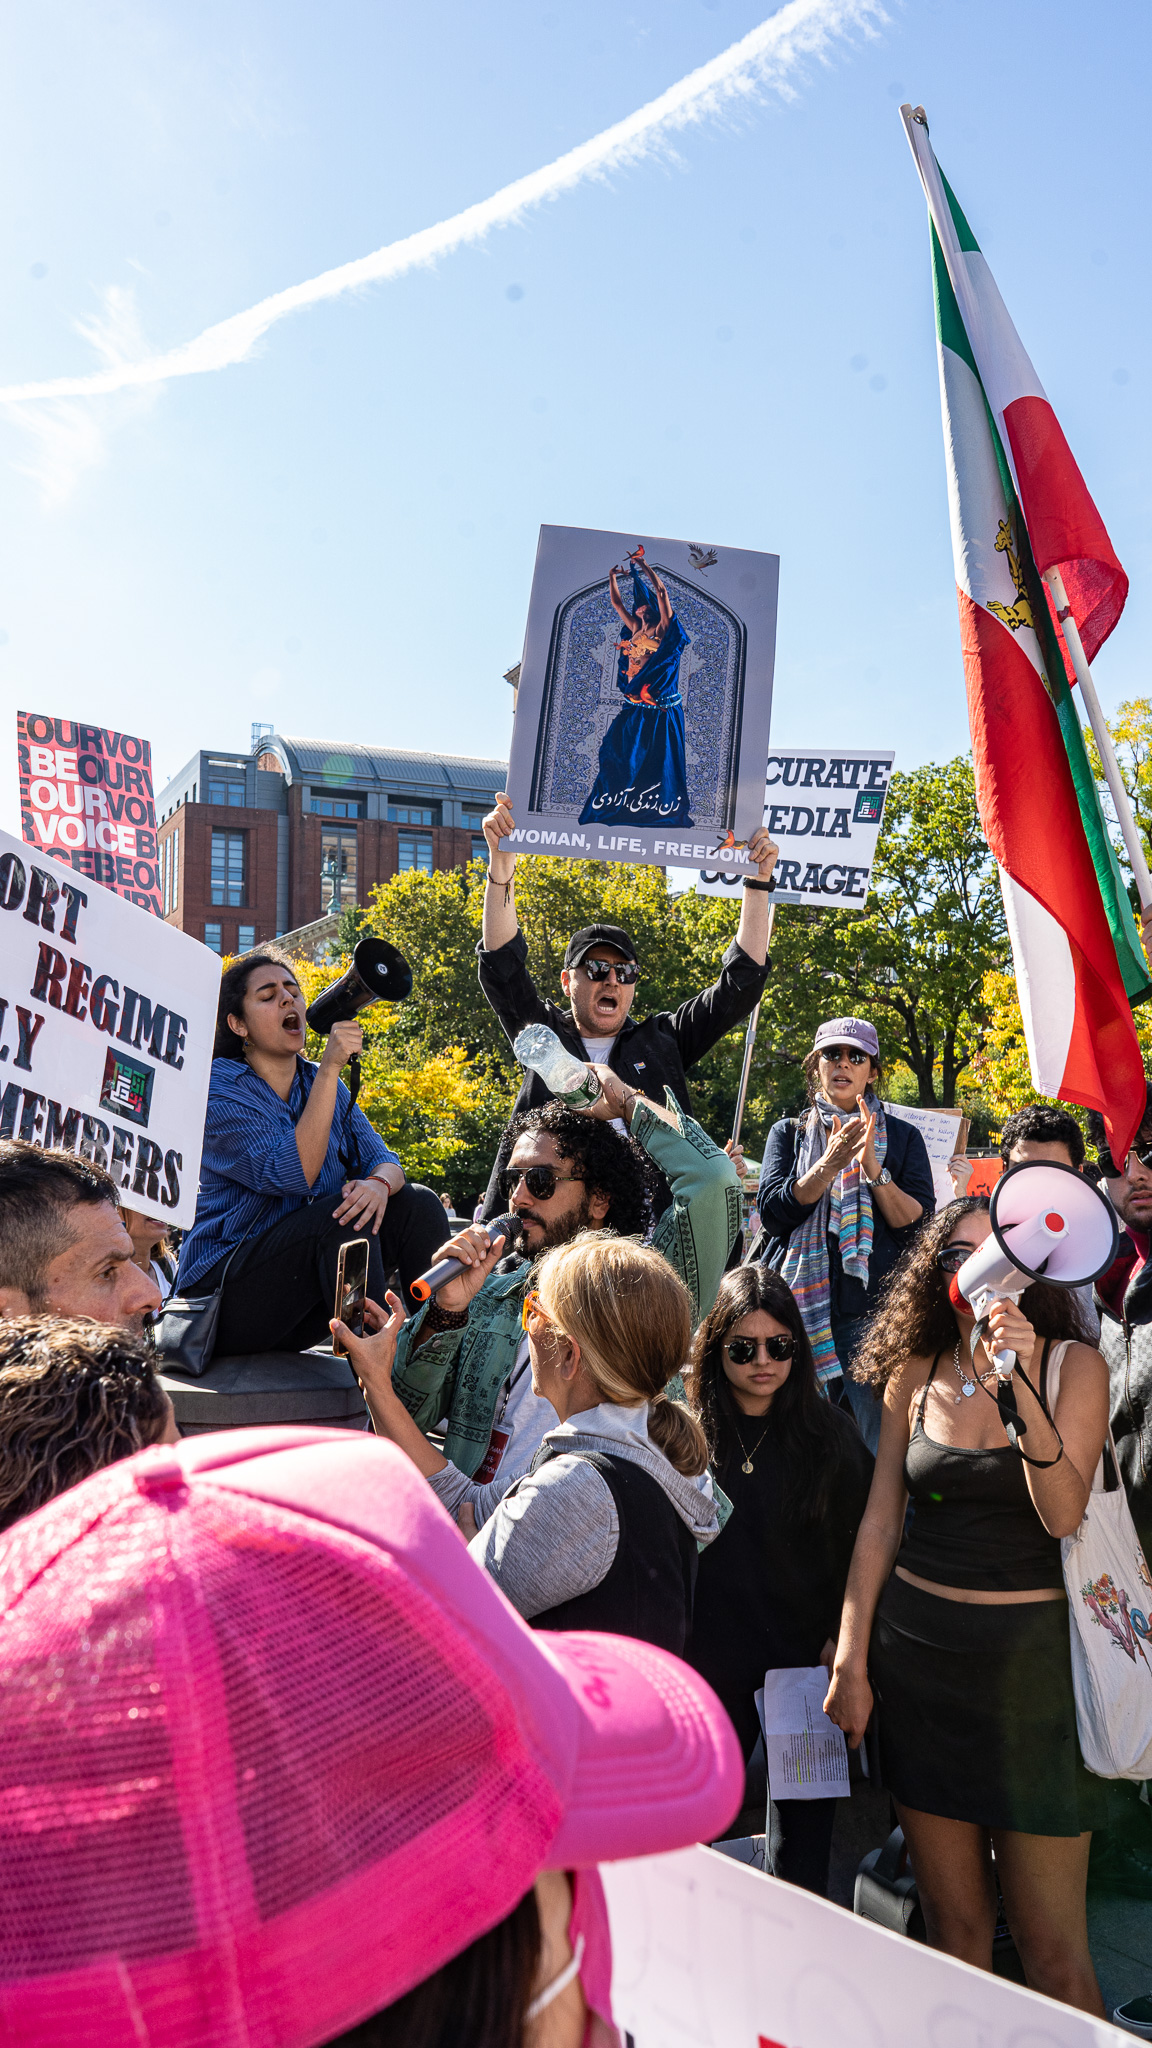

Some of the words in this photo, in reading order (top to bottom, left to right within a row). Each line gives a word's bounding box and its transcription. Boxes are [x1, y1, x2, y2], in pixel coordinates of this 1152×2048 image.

[763, 804, 852, 839] EDIA
[508, 828, 592, 851] WOMAN,
[597, 835, 647, 857] LIFE,
[653, 841, 751, 865] FREEDOM
[30, 940, 188, 1071] REGIME
